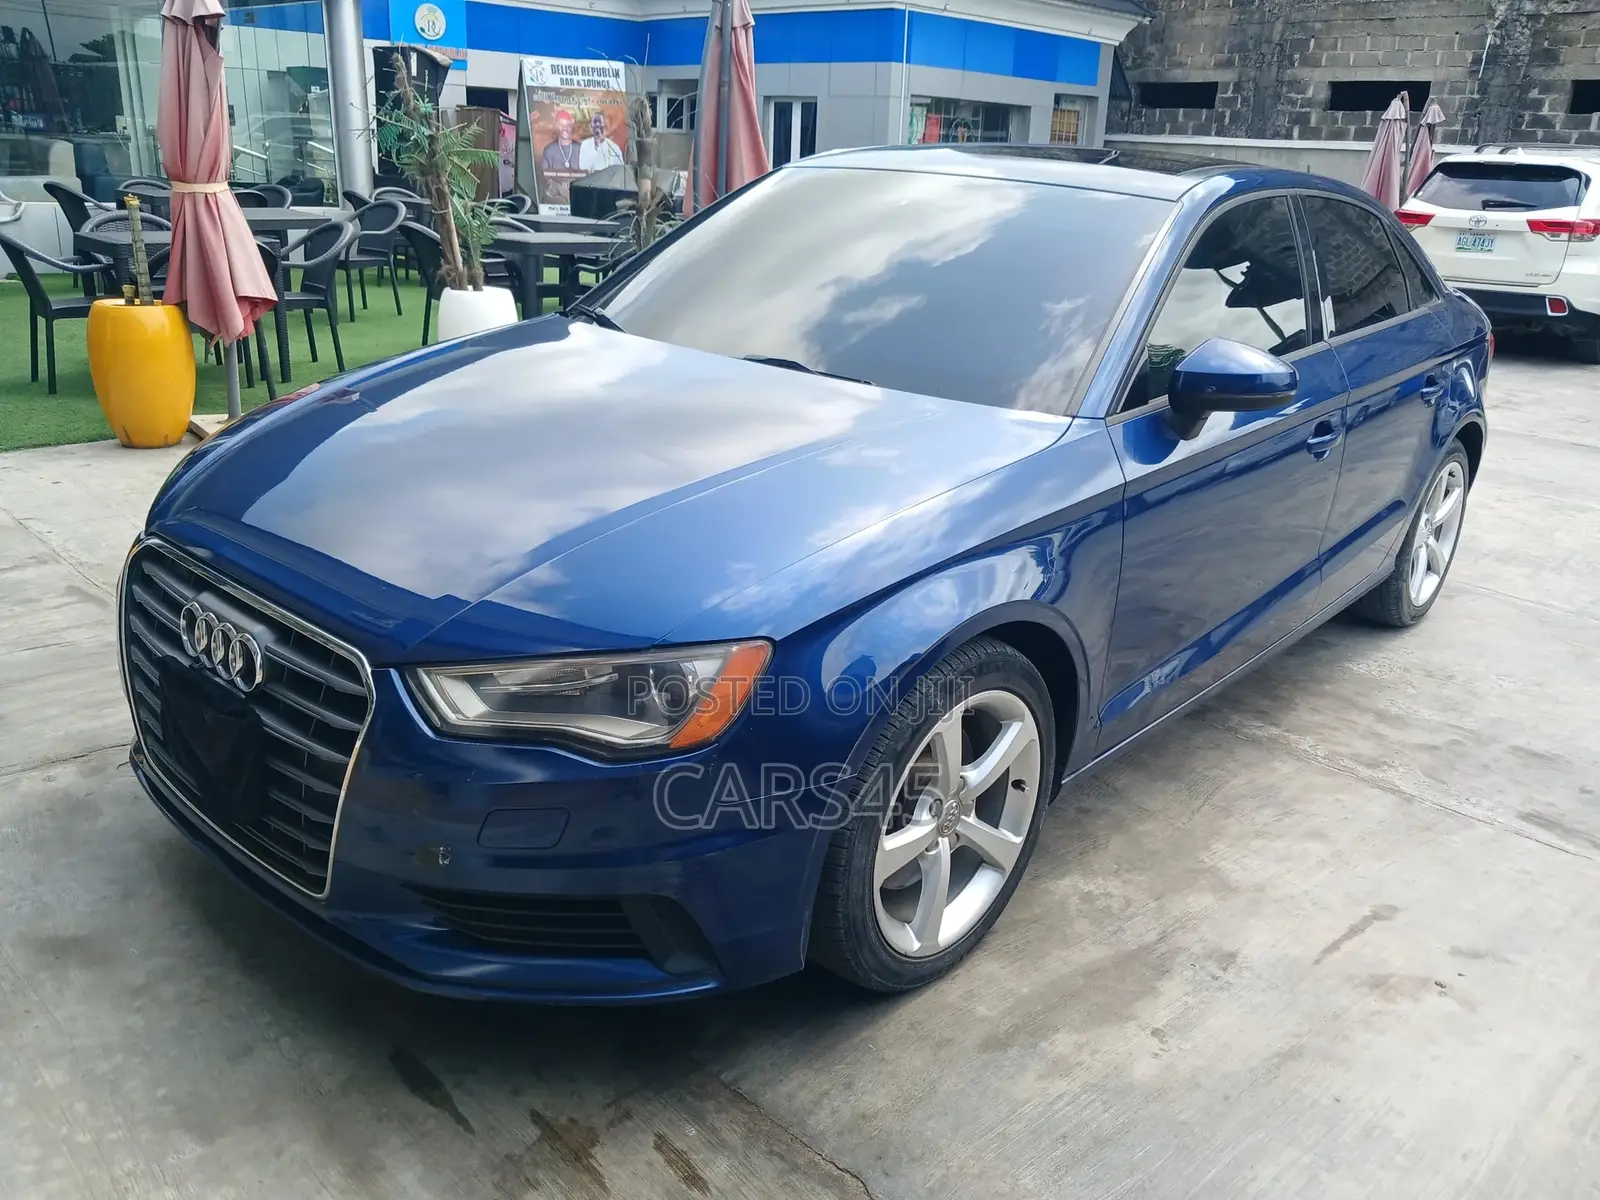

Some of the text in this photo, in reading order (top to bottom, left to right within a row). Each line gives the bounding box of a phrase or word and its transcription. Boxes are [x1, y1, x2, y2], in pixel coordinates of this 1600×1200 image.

[551, 64, 580, 76] DELISH
[560, 77, 575, 87] BAR
[583, 80, 611, 89] LOUNGE
